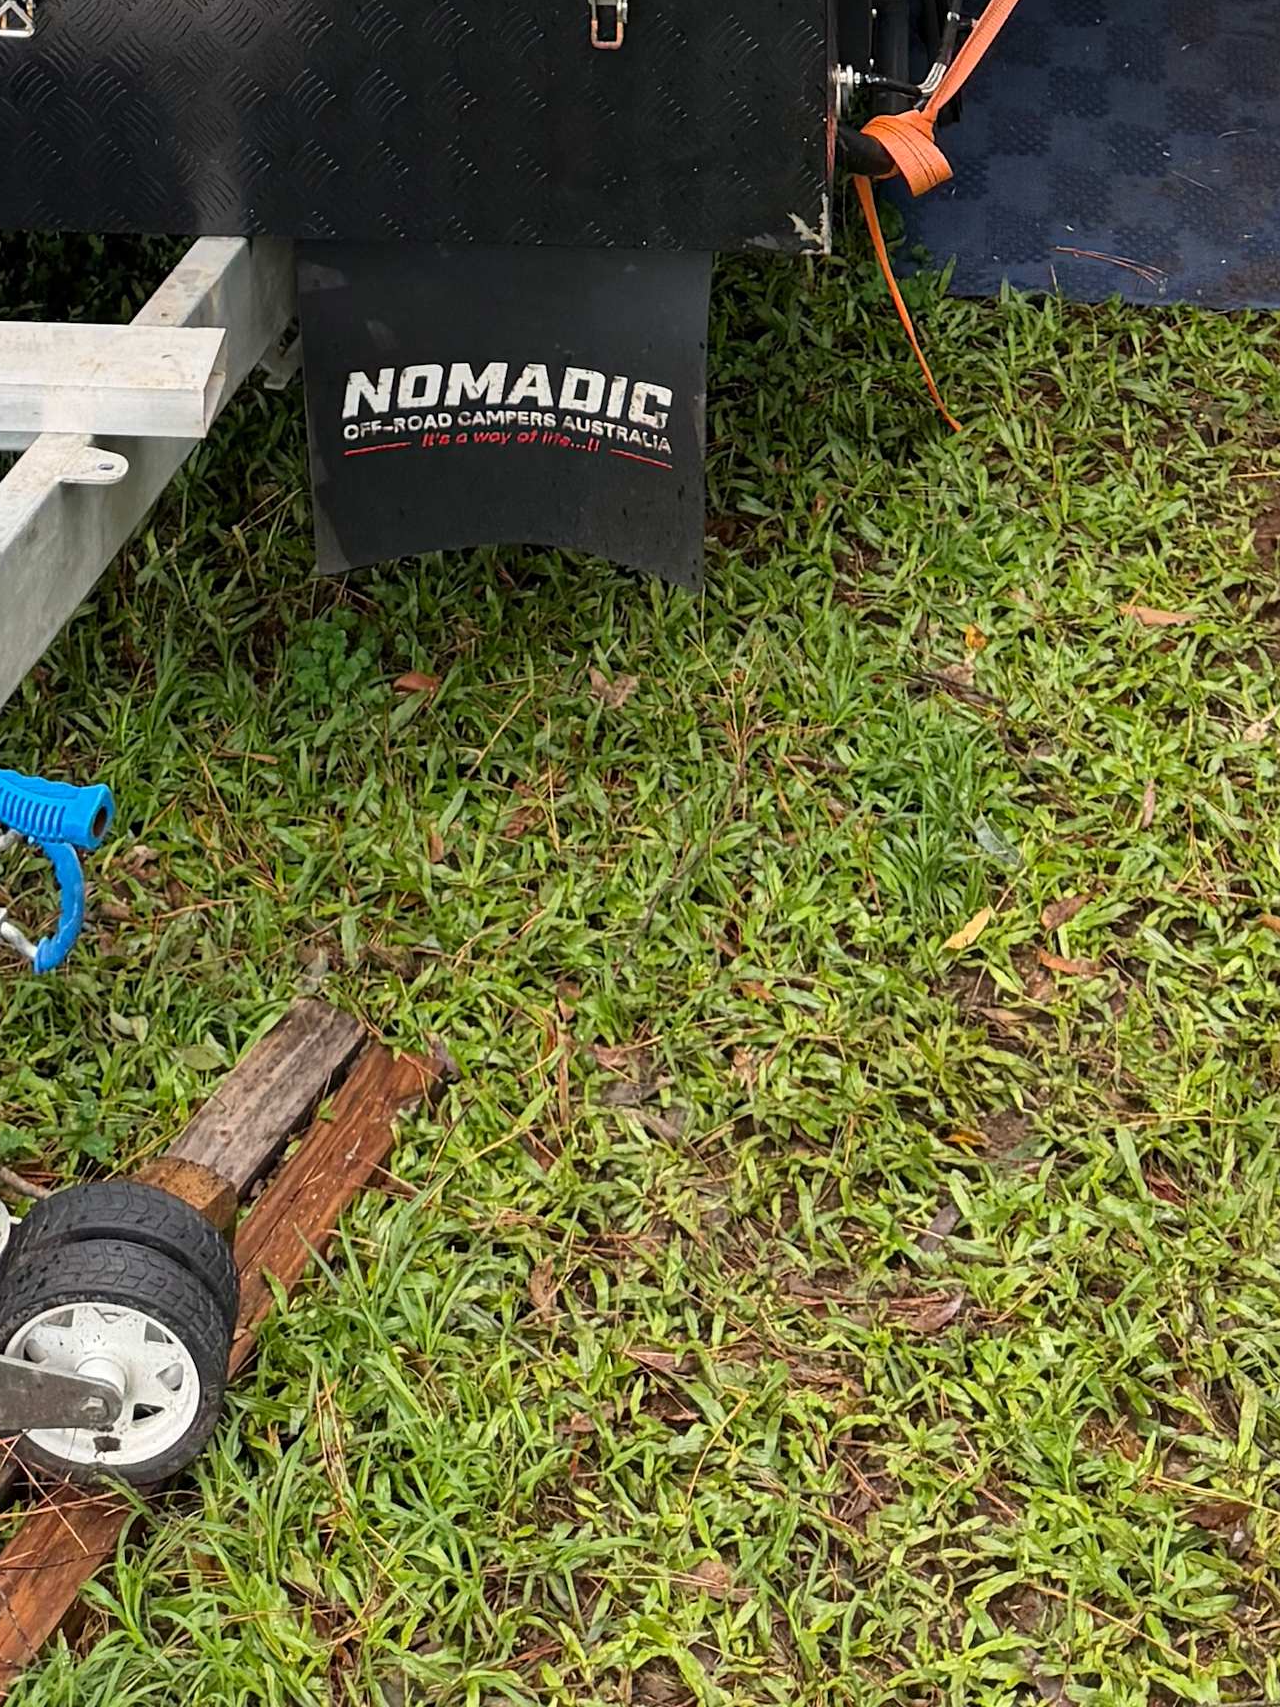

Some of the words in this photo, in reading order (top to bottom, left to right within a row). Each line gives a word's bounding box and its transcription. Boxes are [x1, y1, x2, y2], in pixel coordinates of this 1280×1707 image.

[342, 362, 673, 429] NOMADIC
[343, 412, 453, 441] OFF-ROAD
[457, 410, 557, 428] CAMPERS
[562, 415, 673, 454] AUSTRALIA
[421, 432, 450, 448] It's
[455, 432, 468, 444] a
[473, 431, 512, 446] way
[516, 428, 539, 444] of
